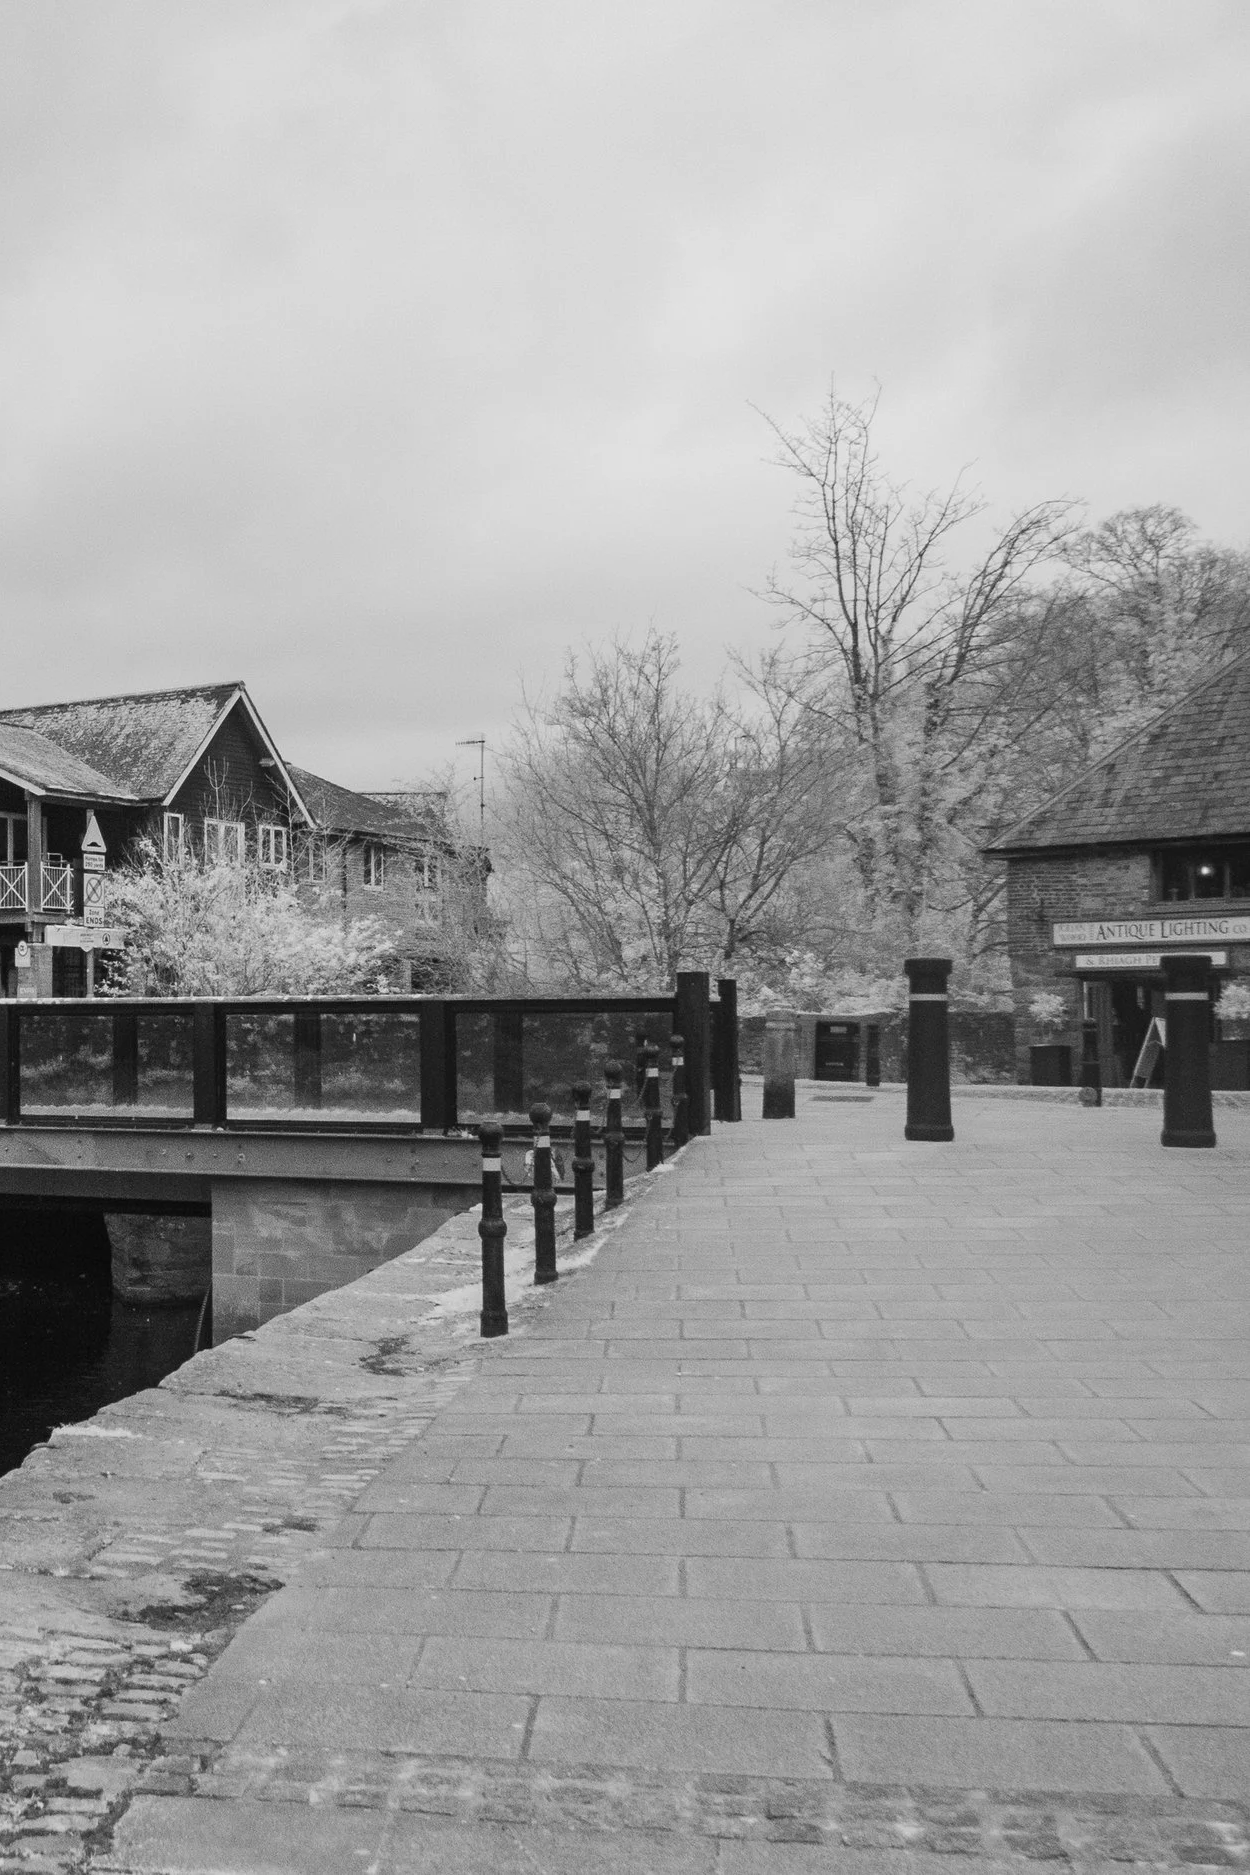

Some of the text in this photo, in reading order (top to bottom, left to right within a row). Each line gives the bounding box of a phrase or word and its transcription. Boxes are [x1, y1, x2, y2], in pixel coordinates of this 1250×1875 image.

[86, 917, 103, 925] ENDS
[1097, 923, 1155, 941] ANTIQUE
[1160, 920, 1229, 939] LIGHTING
[1086, 956, 1094, 966] &
